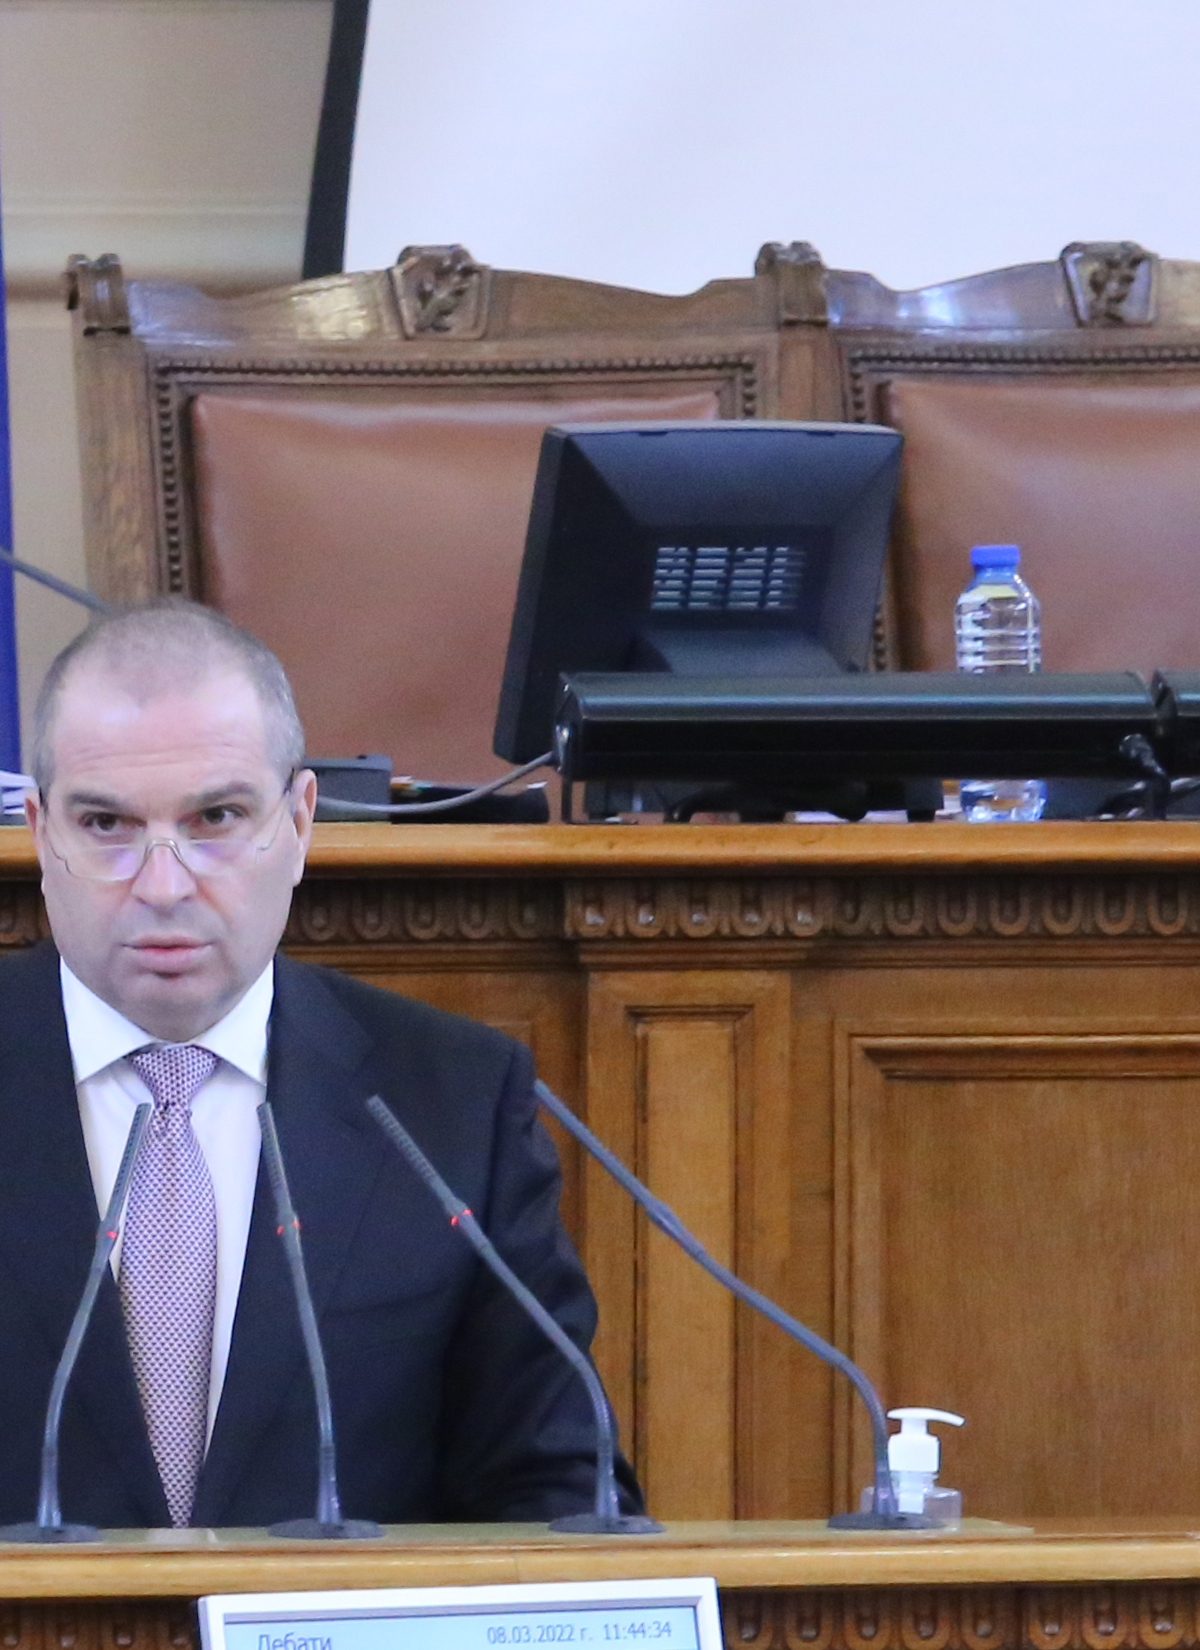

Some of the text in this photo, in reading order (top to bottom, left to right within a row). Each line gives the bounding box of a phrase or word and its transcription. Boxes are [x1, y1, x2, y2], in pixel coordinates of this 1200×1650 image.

[258, 1632, 332, 1650] Дебати
[487, 1621, 672, 1644] 08.03.2022 г. 11:44:34
